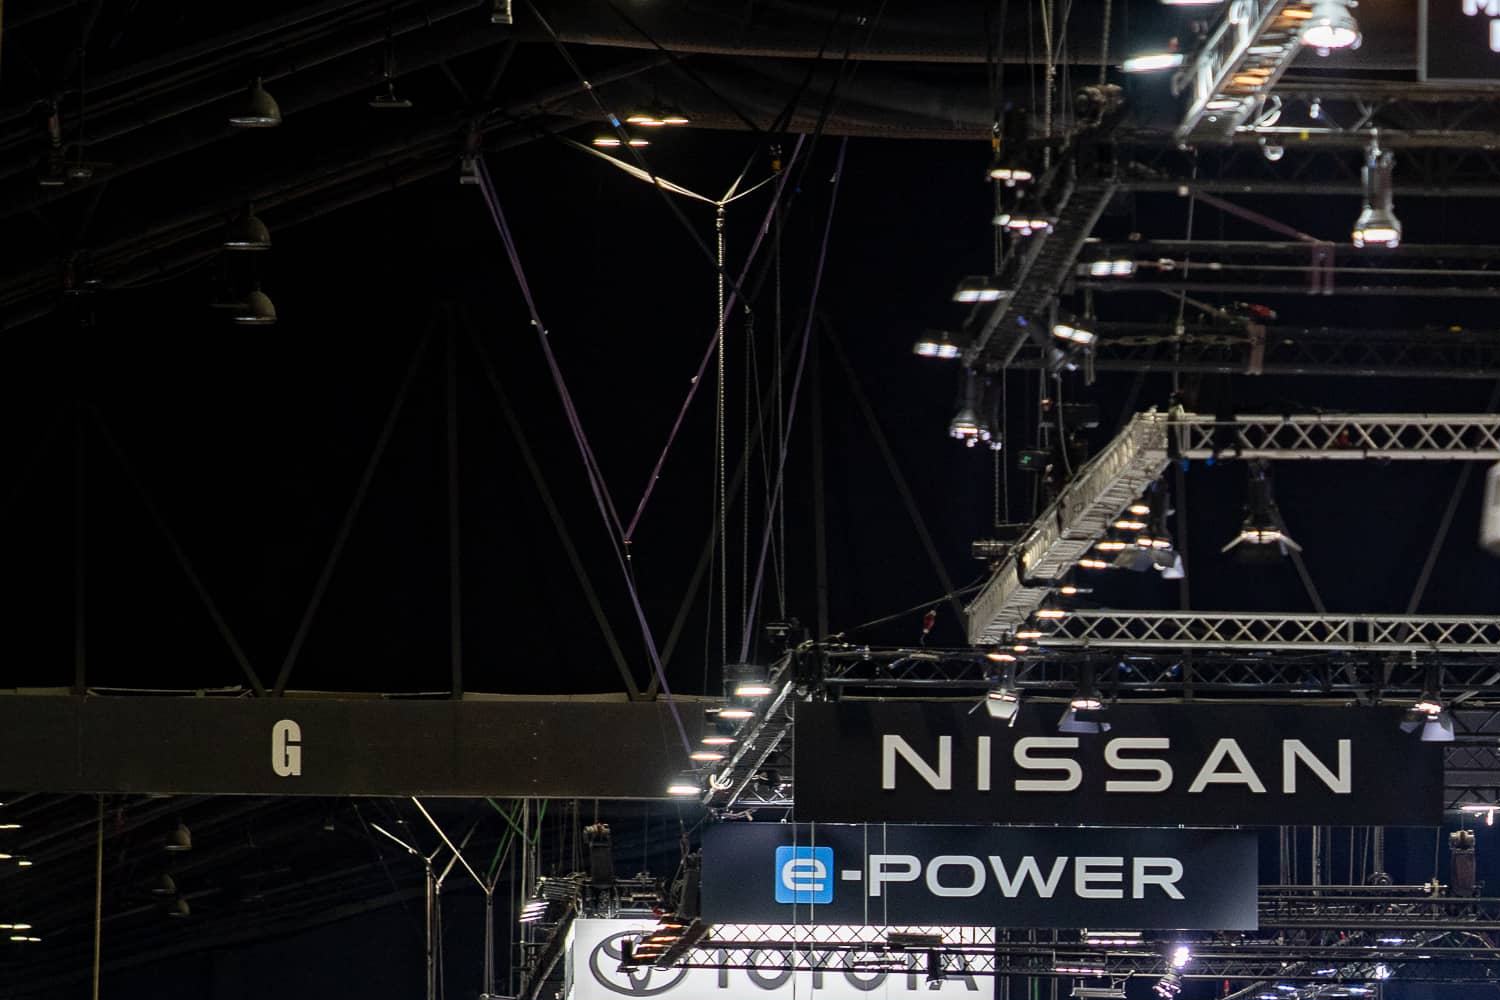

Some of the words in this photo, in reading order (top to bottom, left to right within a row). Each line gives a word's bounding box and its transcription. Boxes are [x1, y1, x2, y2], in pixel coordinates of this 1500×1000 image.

[272, 719, 301, 777] G
[882, 735, 1352, 794] NISSAN
[780, 855, 1186, 901] e-POWER
